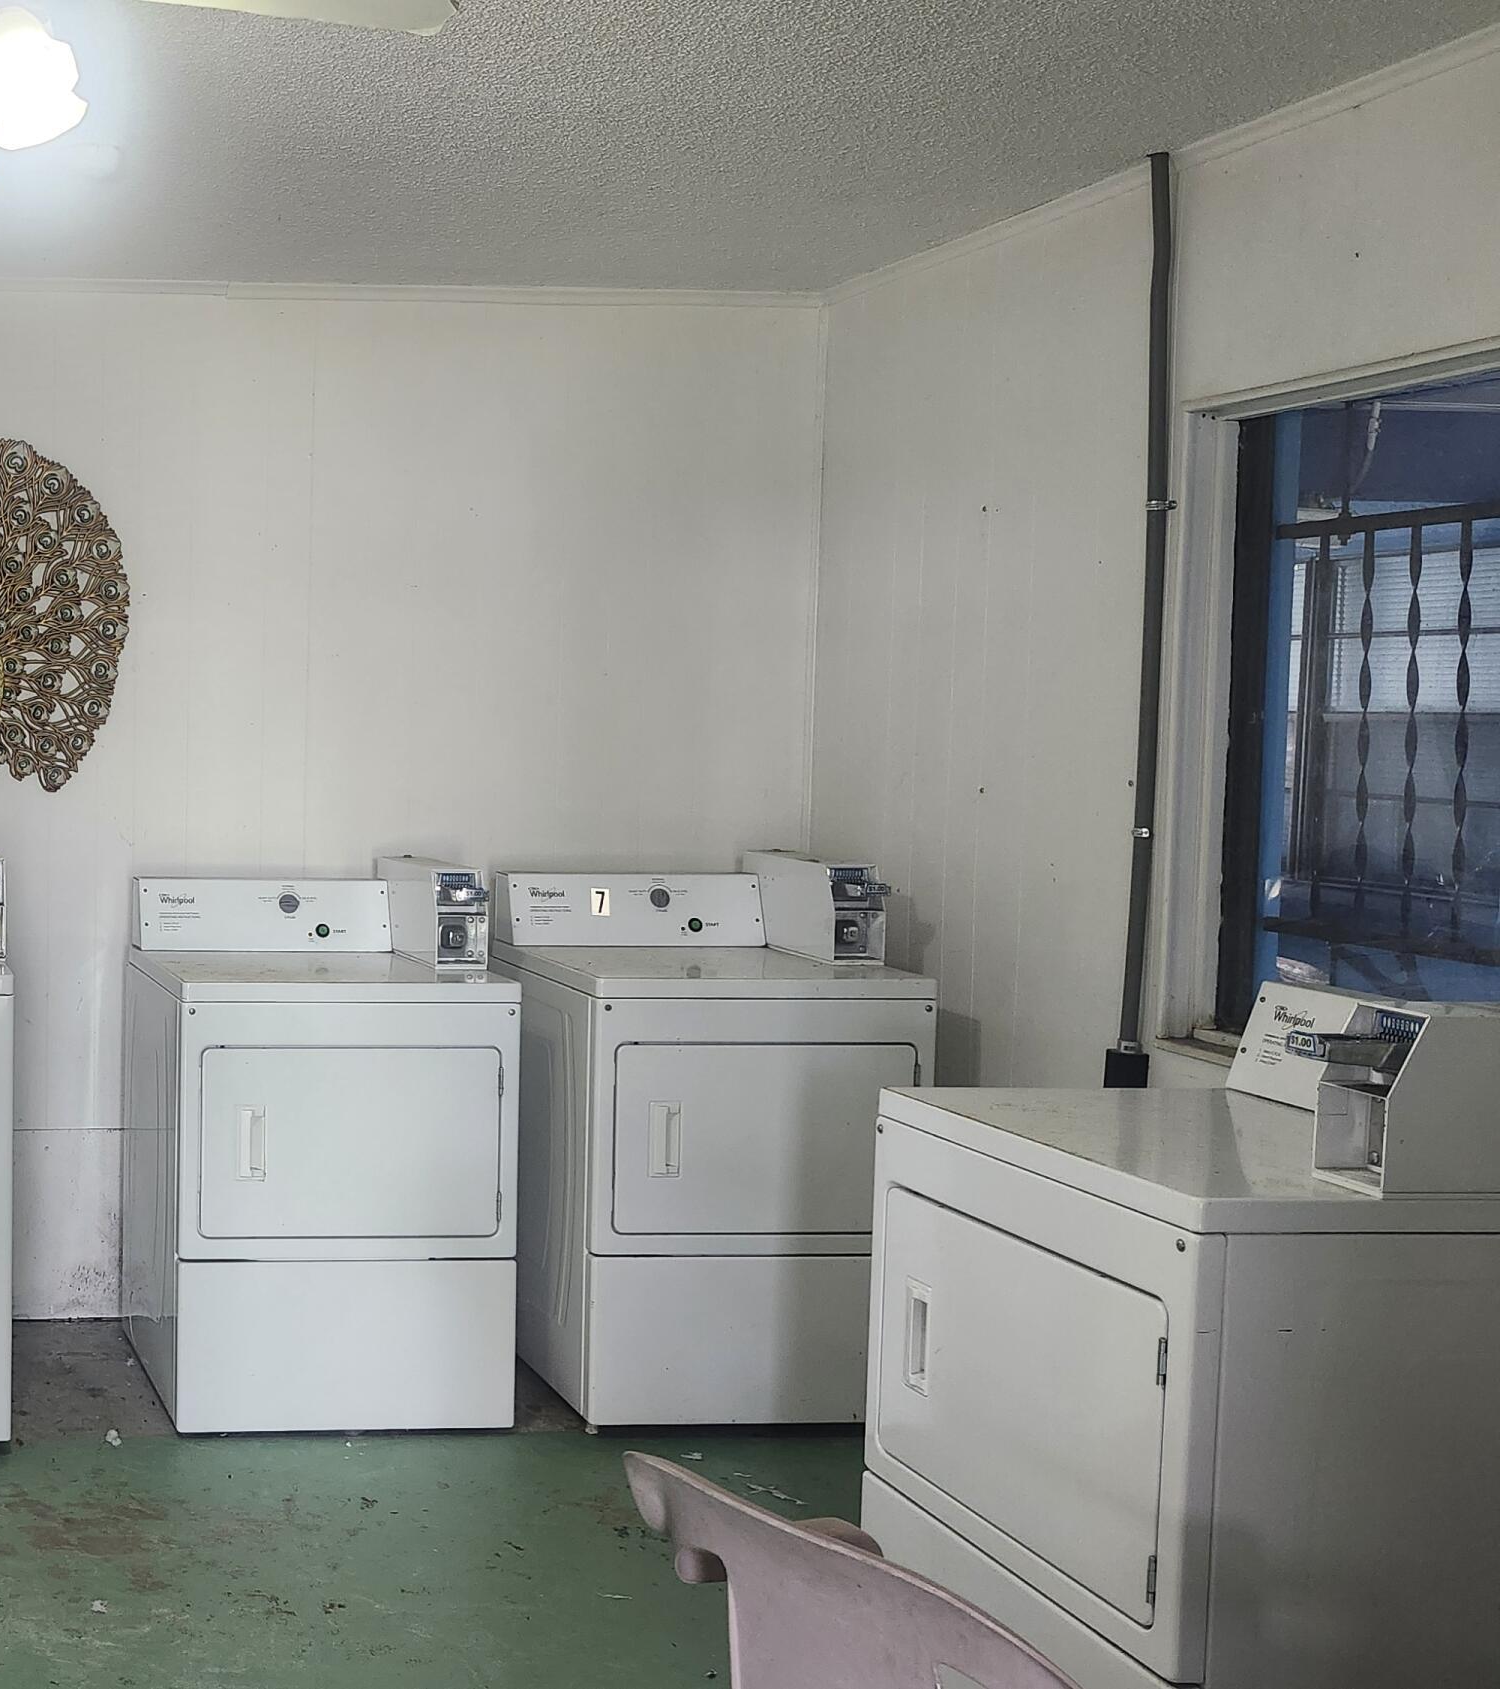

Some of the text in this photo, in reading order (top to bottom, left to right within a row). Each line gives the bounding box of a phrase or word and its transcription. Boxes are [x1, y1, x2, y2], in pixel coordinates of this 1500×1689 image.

[159, 896, 195, 906] Whirlpool
[529, 890, 565, 899] Whirlpool
[595, 891, 605, 914] 7
[1274, 1010, 1316, 1029] Whirlpool
[1290, 1035, 1312, 1048] $1.00
